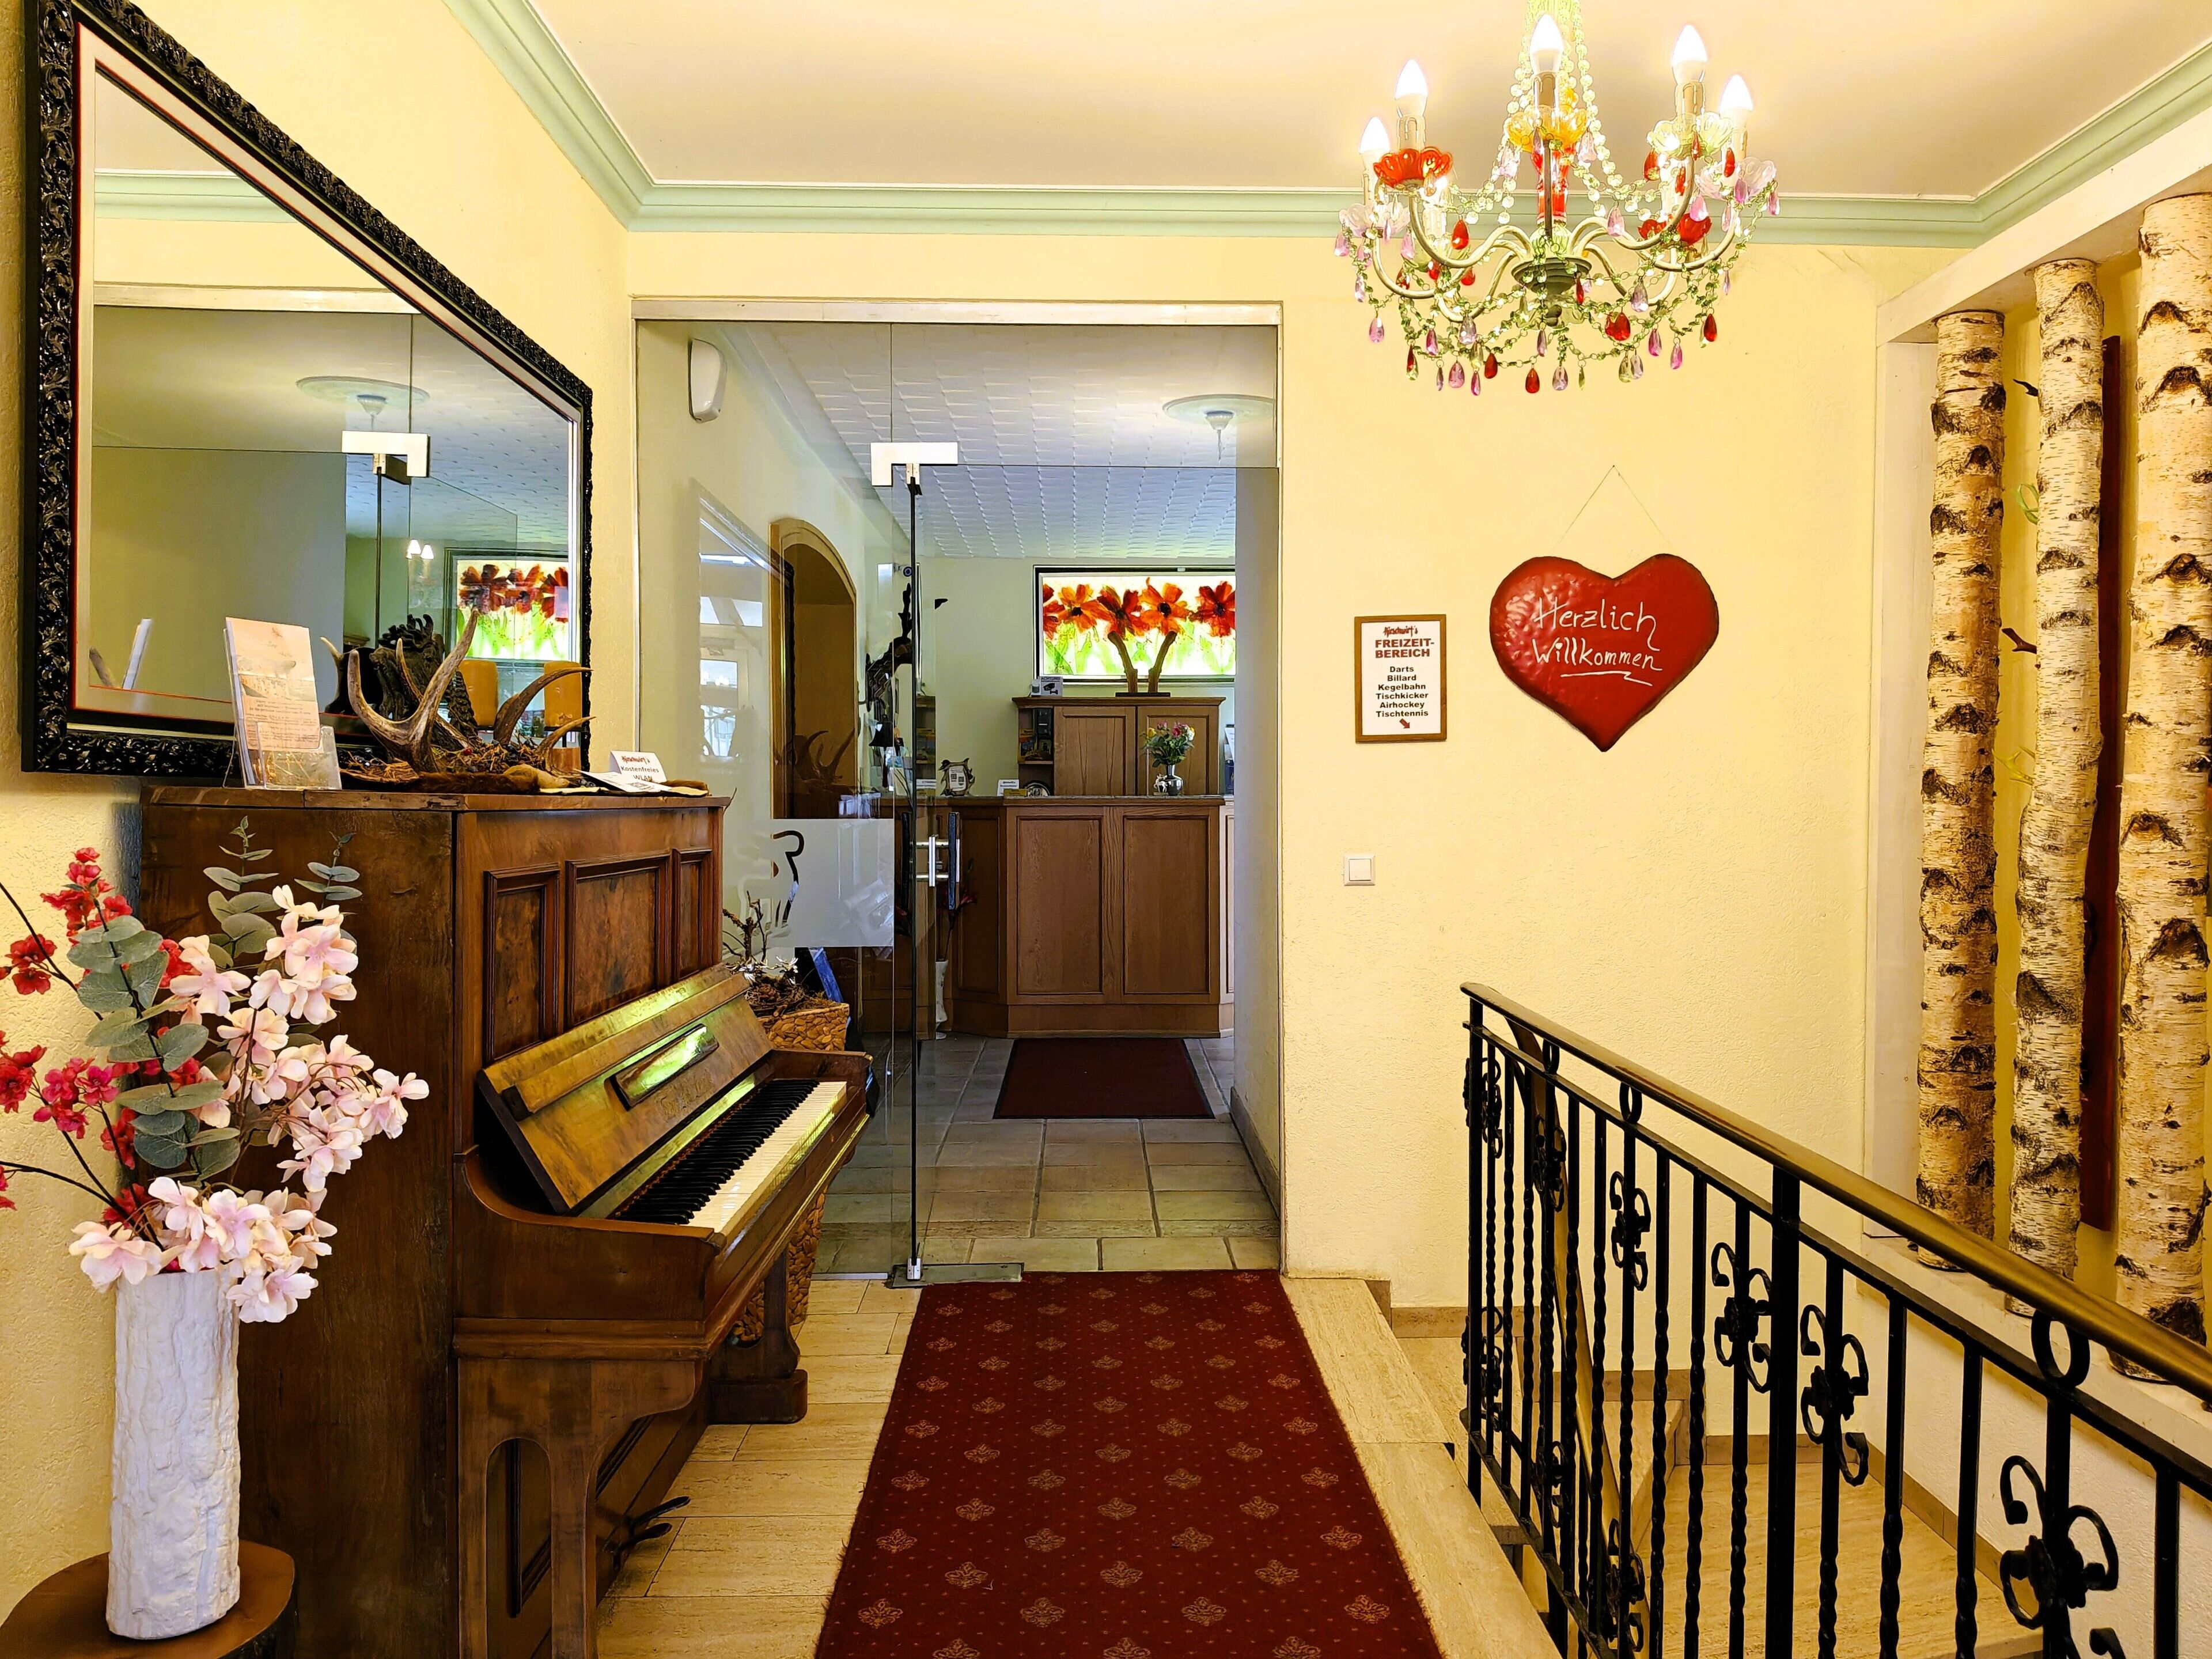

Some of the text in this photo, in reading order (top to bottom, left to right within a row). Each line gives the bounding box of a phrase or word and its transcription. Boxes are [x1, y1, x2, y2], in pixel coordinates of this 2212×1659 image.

[1533, 596, 1660, 652] Herzlich
[1375, 638, 1434, 648] FREIZEIT-
[1375, 649, 1430, 658] BEREICH
[1531, 637, 1663, 671] Willkommen
[1378, 683, 1426, 692] Kegelbahn
[1380, 701, 1425, 709] Airhockey
[1376, 710, 1429, 718] Tischtennis
